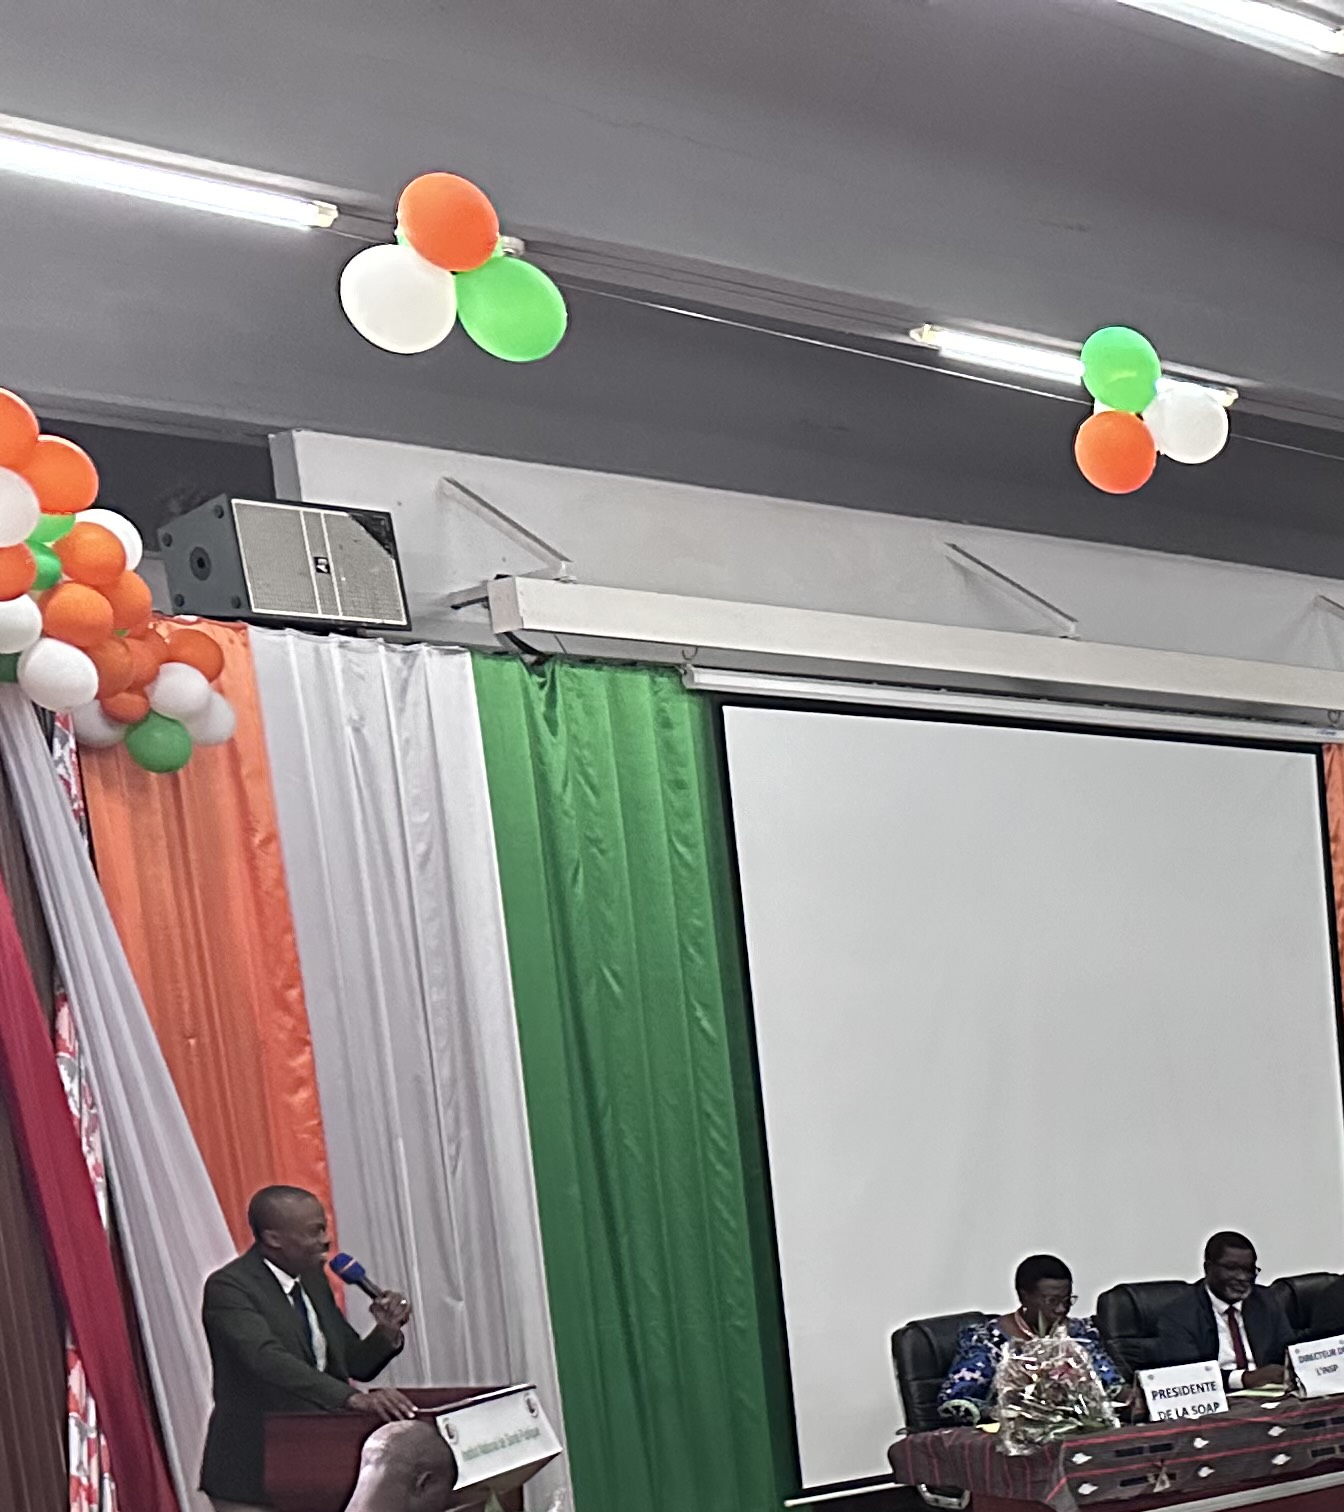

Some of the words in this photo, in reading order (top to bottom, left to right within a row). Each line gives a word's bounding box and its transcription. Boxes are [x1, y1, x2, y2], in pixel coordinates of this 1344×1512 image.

[1298, 1348, 1337, 1363] DIRECTEUR
[1151, 1381, 1218, 1401] PRESIDENTE
[1158, 1408, 1173, 1421] DE
[1175, 1406, 1190, 1418] LA
[1191, 1402, 1220, 1416] SOAP
